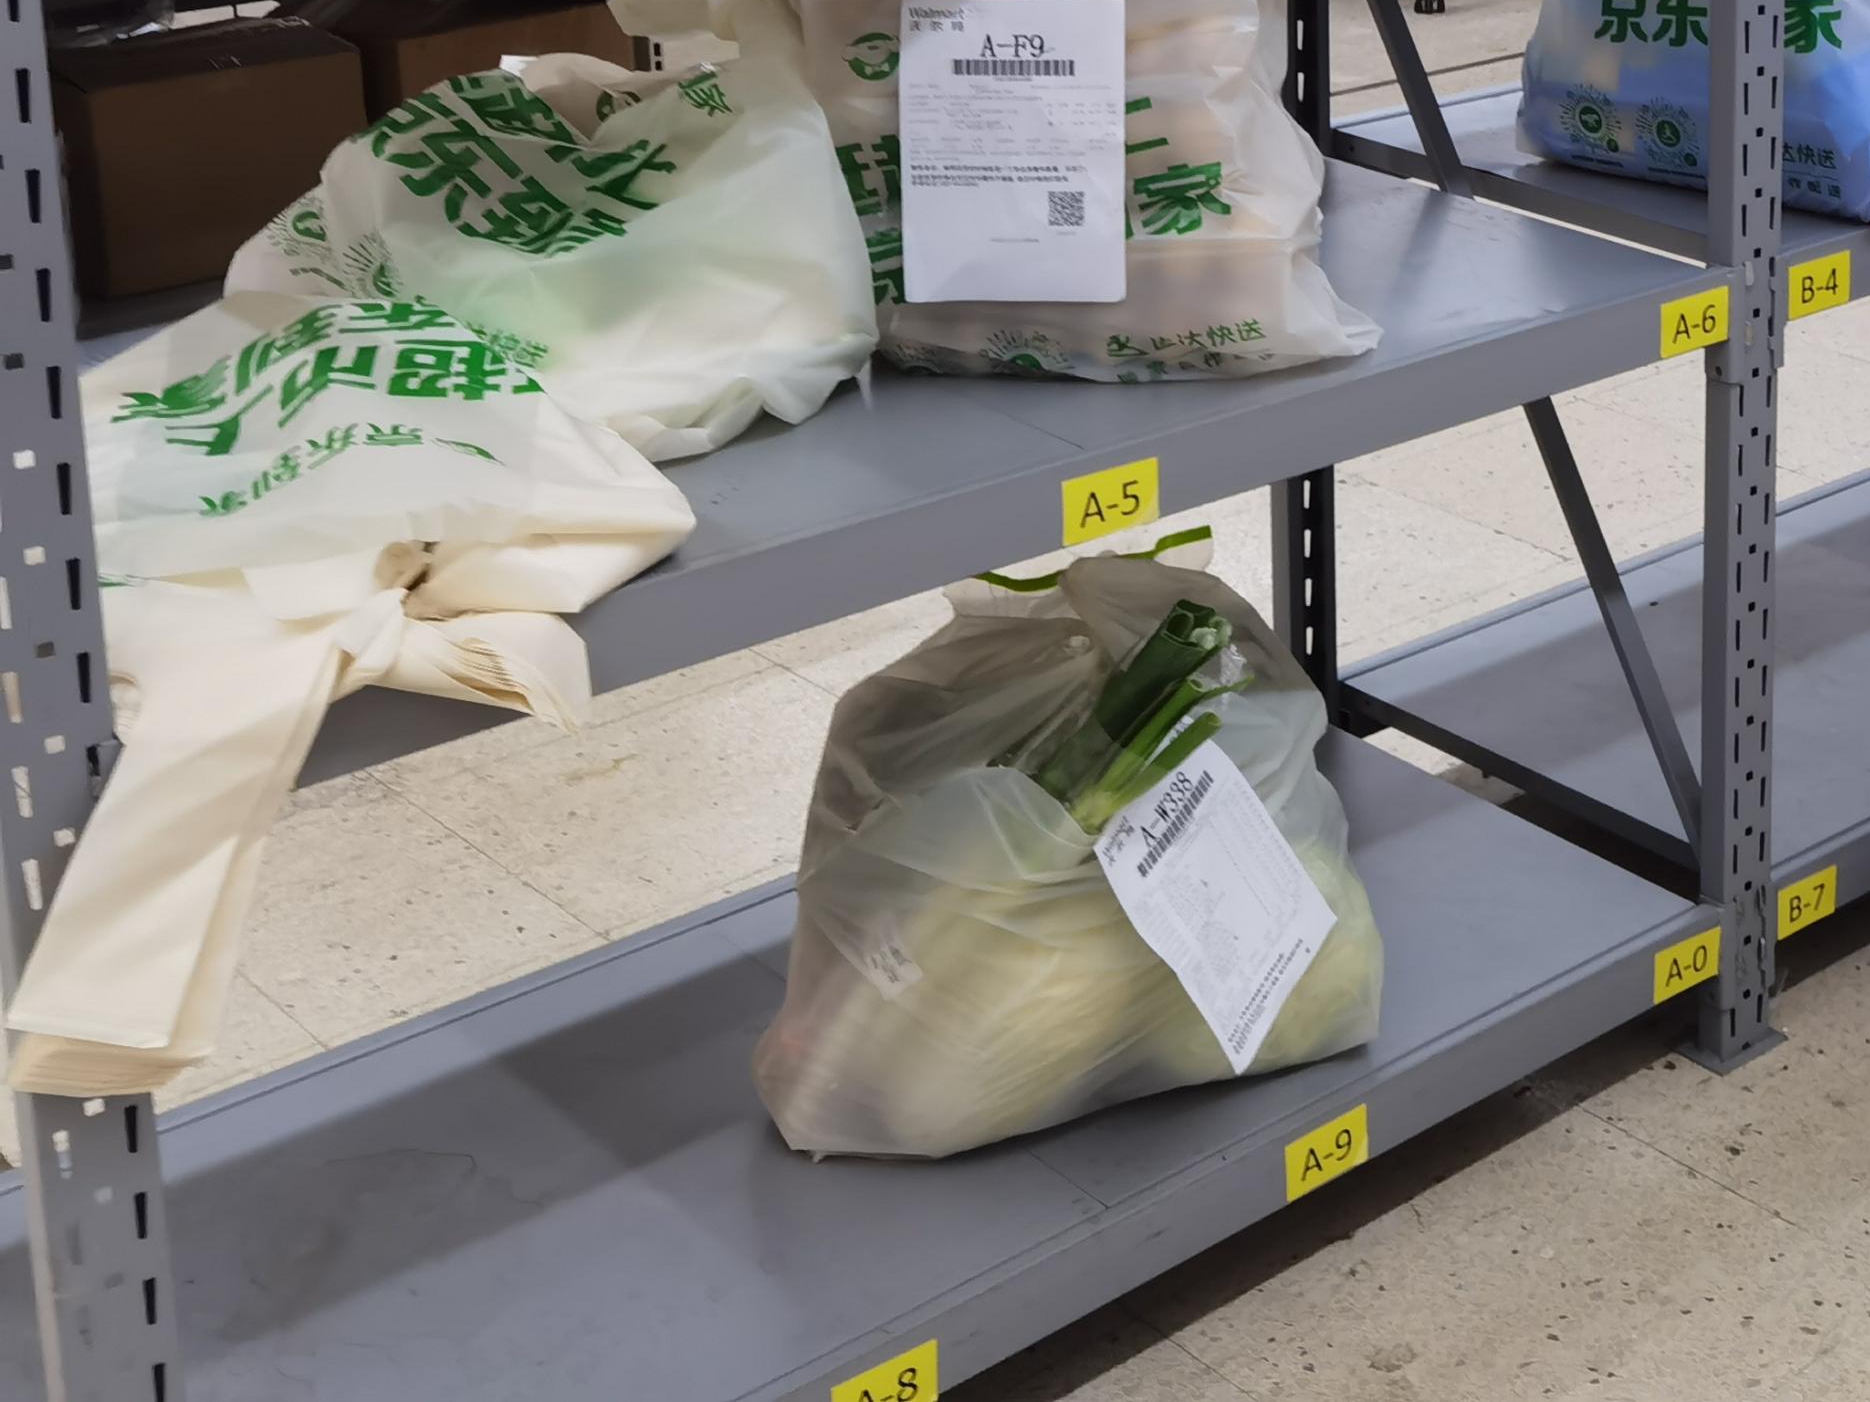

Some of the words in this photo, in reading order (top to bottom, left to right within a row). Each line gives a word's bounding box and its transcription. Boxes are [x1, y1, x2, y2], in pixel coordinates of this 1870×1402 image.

[980, 33, 1046, 58] A-F9
[1801, 267, 1839, 305] B-4
[1671, 303, 1717, 345] A-6
[1079, 479, 1141, 529] A-5
[1139, 770, 1195, 849] A-W338
[1789, 882, 1826, 924] B-7
[1664, 944, 1709, 988] A-0
[1300, 1128, 1352, 1182] A-9
